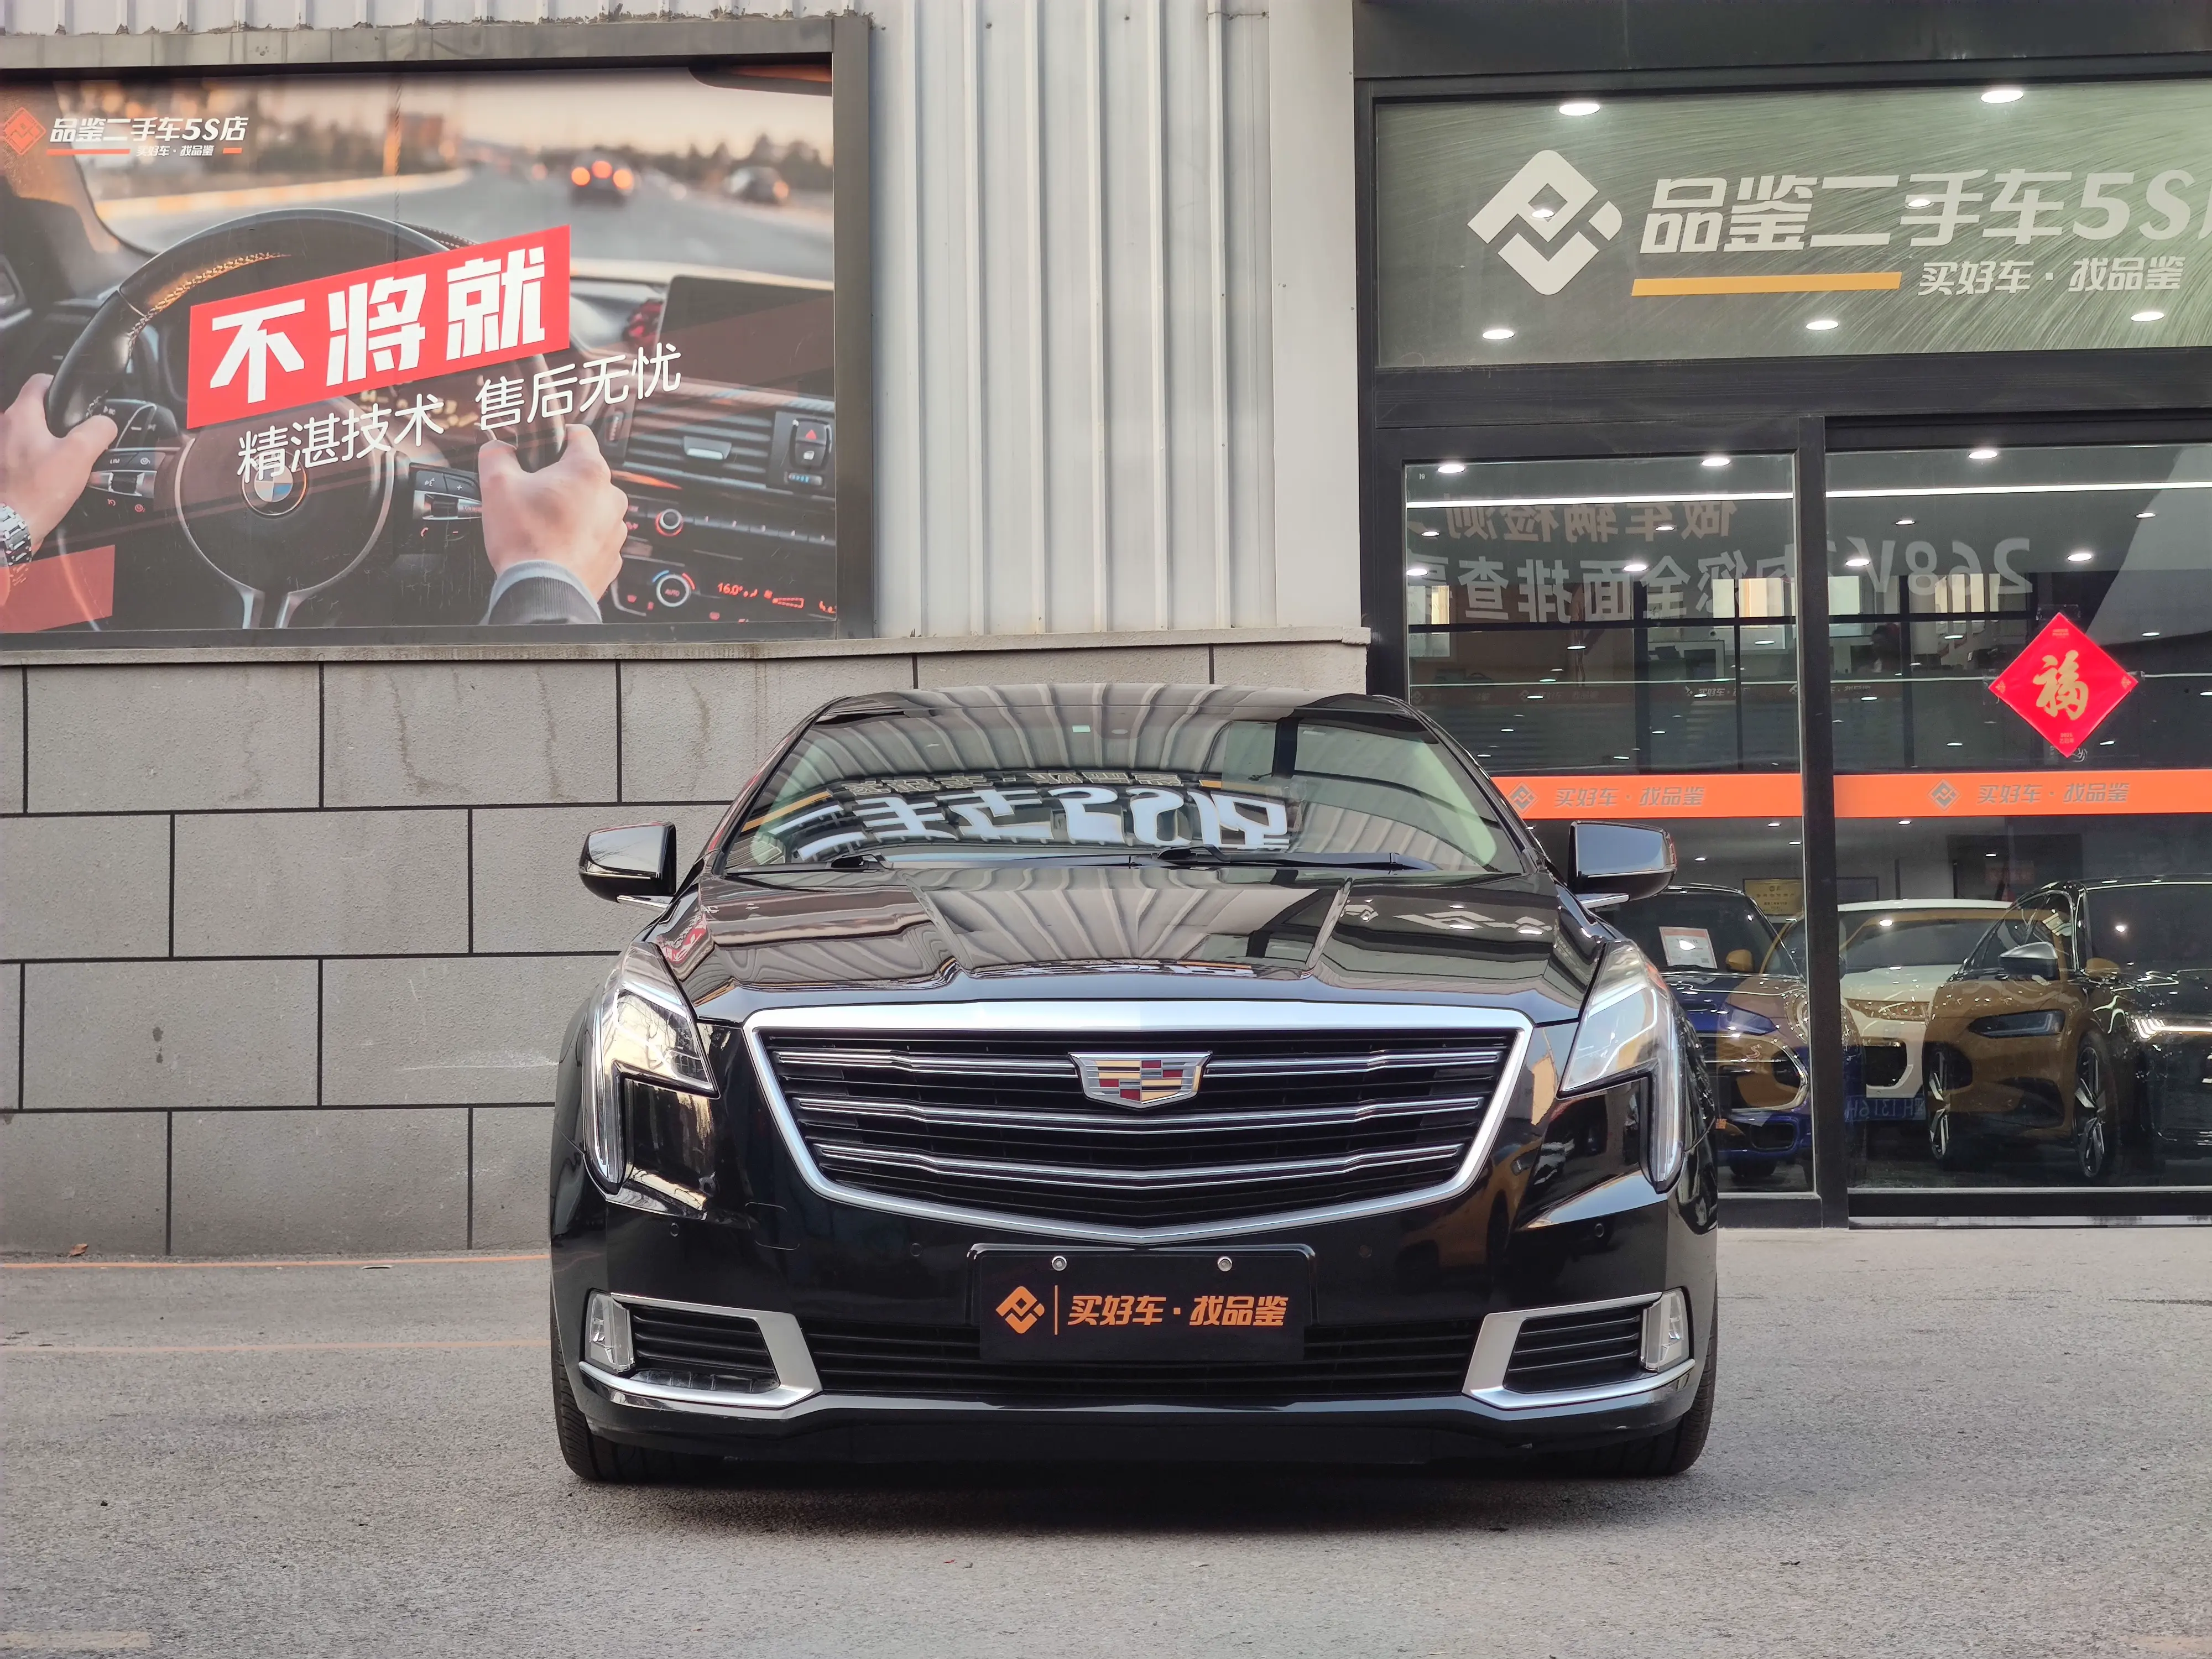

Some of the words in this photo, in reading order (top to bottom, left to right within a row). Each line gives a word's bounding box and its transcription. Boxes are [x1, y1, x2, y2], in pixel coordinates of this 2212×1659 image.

[50, 116, 249, 143] 品鉴二手车5S店
[1639, 168, 2212, 254] 品鉴二手车5S
[210, 246, 546, 404] 不将就
[236, 393, 444, 483] 精湛技术
[474, 342, 682, 431] 售后无忧
[2033, 650, 2089, 721] 福
